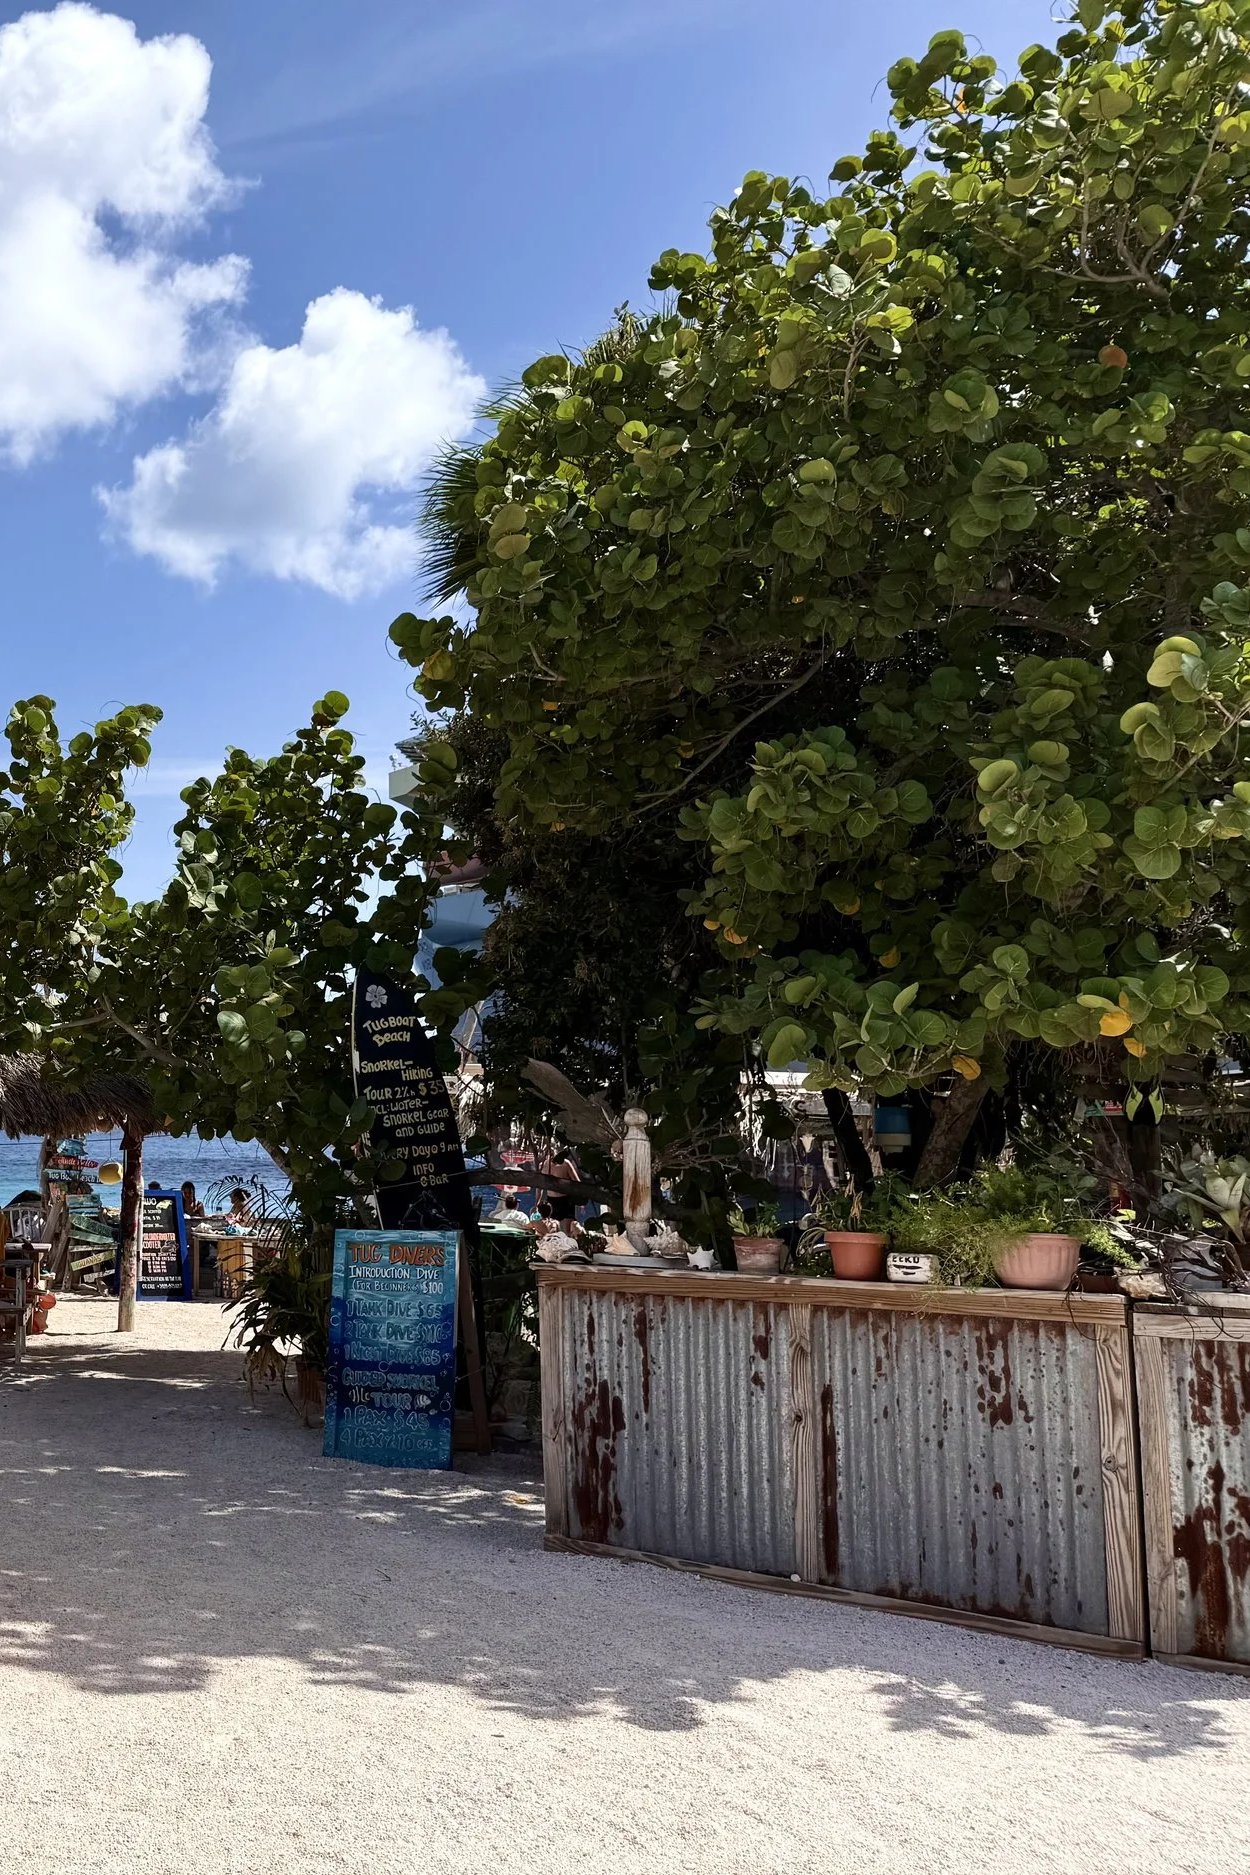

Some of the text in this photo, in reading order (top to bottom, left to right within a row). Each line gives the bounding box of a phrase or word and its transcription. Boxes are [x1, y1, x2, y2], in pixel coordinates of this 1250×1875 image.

[363, 1085, 393, 1101] TOUR
[412, 1162, 435, 1176] INFO
[348, 1243, 382, 1263] TUG
[348, 1265, 439, 1280] INTRODUCTION DIVE
[352, 1279, 371, 1291] (FOR
[422, 1281, 444, 1294] $100
[355, 1298, 383, 1317] TANK
[353, 1319, 383, 1339] TANK
[370, 1391, 412, 1410] TOUR
